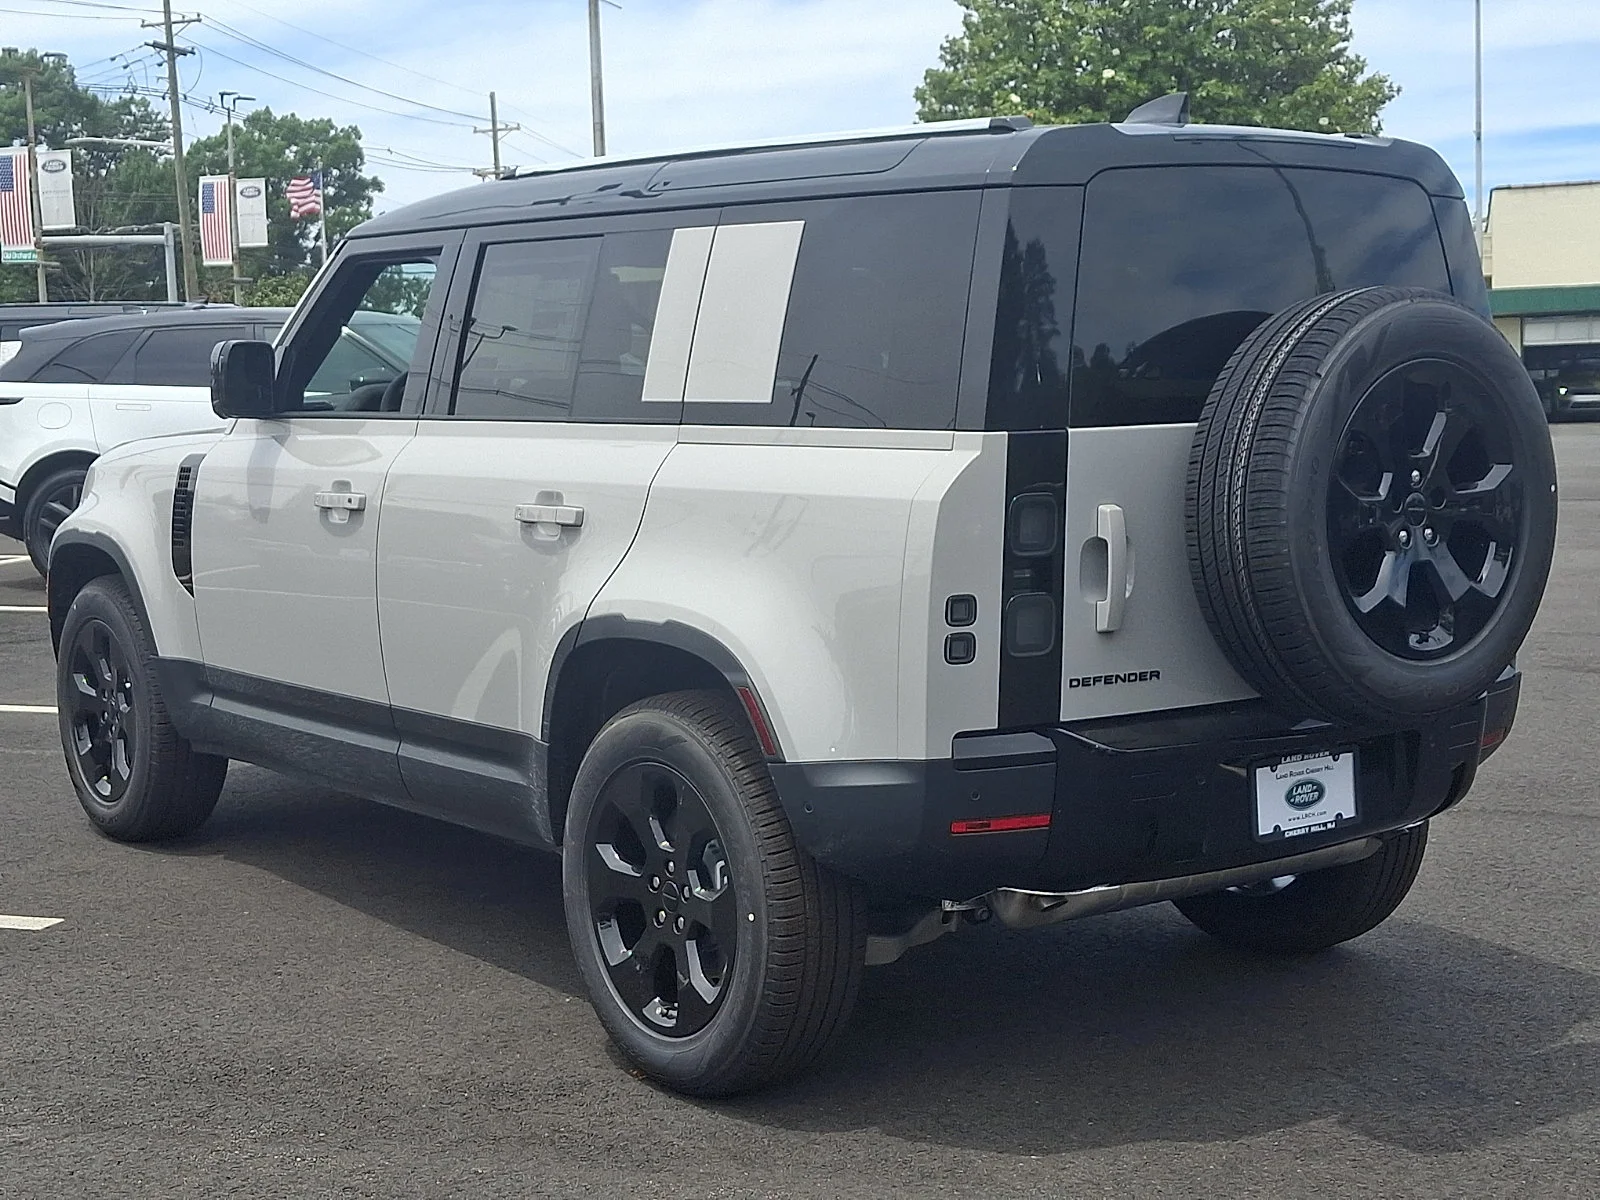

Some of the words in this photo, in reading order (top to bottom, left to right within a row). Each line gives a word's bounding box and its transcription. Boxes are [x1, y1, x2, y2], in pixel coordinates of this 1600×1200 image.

[1069, 670, 1161, 688] DEFENDER
[1281, 754, 1303, 763] LAND
[1293, 784, 1313, 795] LAND
[1294, 791, 1319, 804] ROVER
[1285, 827, 1310, 837] CHERRY
[1326, 821, 1336, 830] NJ
